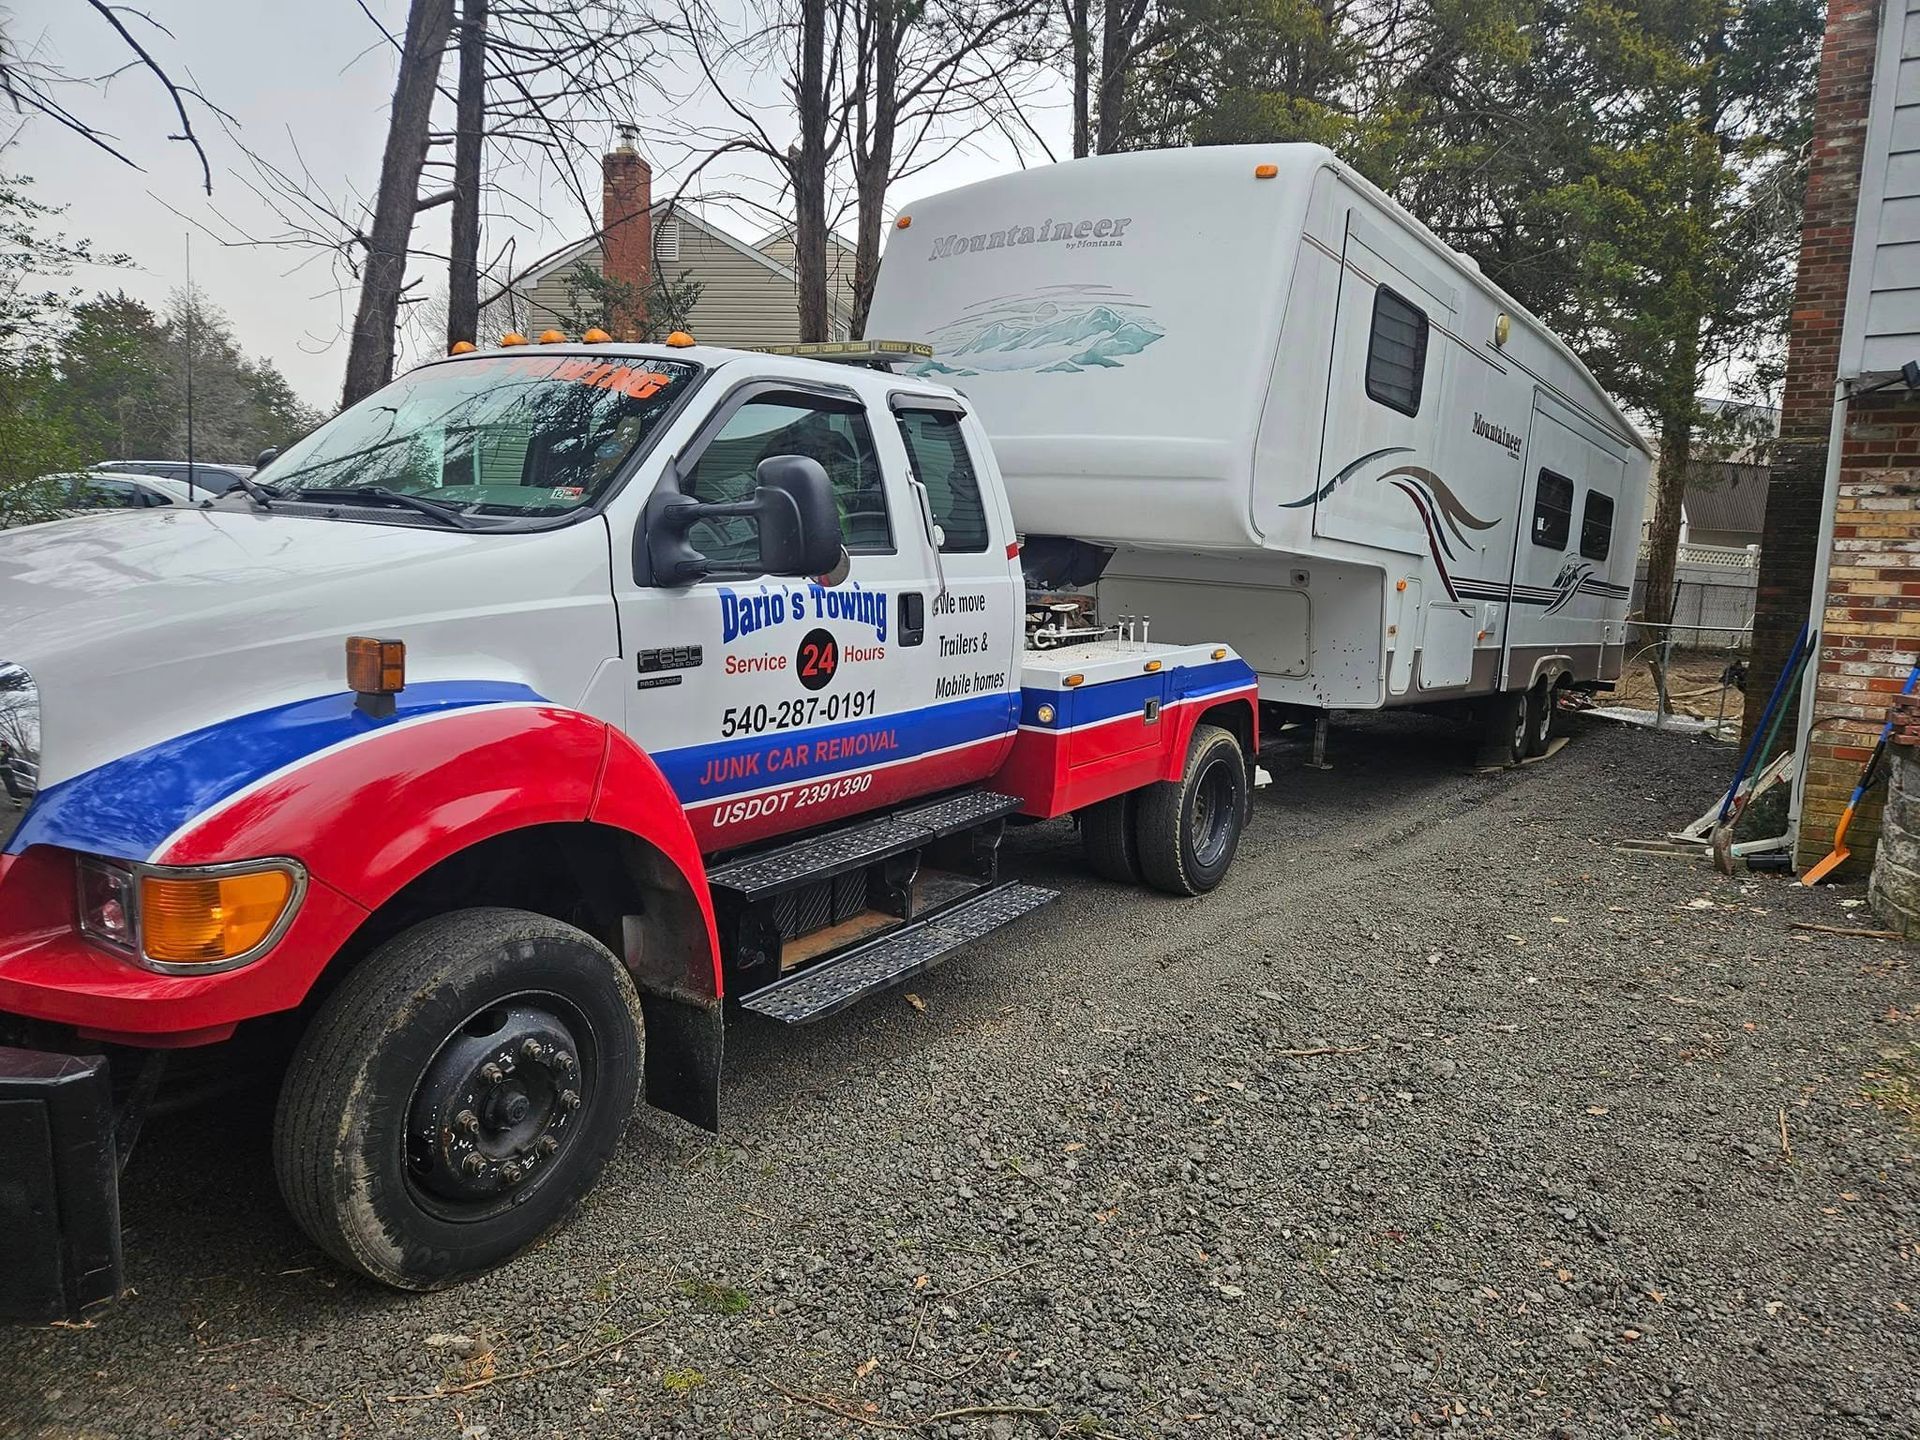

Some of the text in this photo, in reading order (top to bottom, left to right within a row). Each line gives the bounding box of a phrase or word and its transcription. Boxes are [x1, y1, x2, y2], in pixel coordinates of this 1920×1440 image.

[928, 218, 1132, 261] Mountaineer
[1077, 240, 1122, 248] Montana
[1472, 411, 1522, 453] Mountaineer
[717, 581, 887, 644] Dario's Towing
[939, 592, 985, 614] We move
[802, 643, 835, 676] 24
[844, 645, 885, 663] Hours
[939, 632, 988, 657] Trailers &
[725, 653, 787, 675] Service
[935, 671, 1005, 699] Mobile homes
[722, 689, 876, 738] 540-287-0191
[700, 729, 899, 785] JUNK CAR REMOVAL
[713, 773, 873, 828] USDOT 2391390
